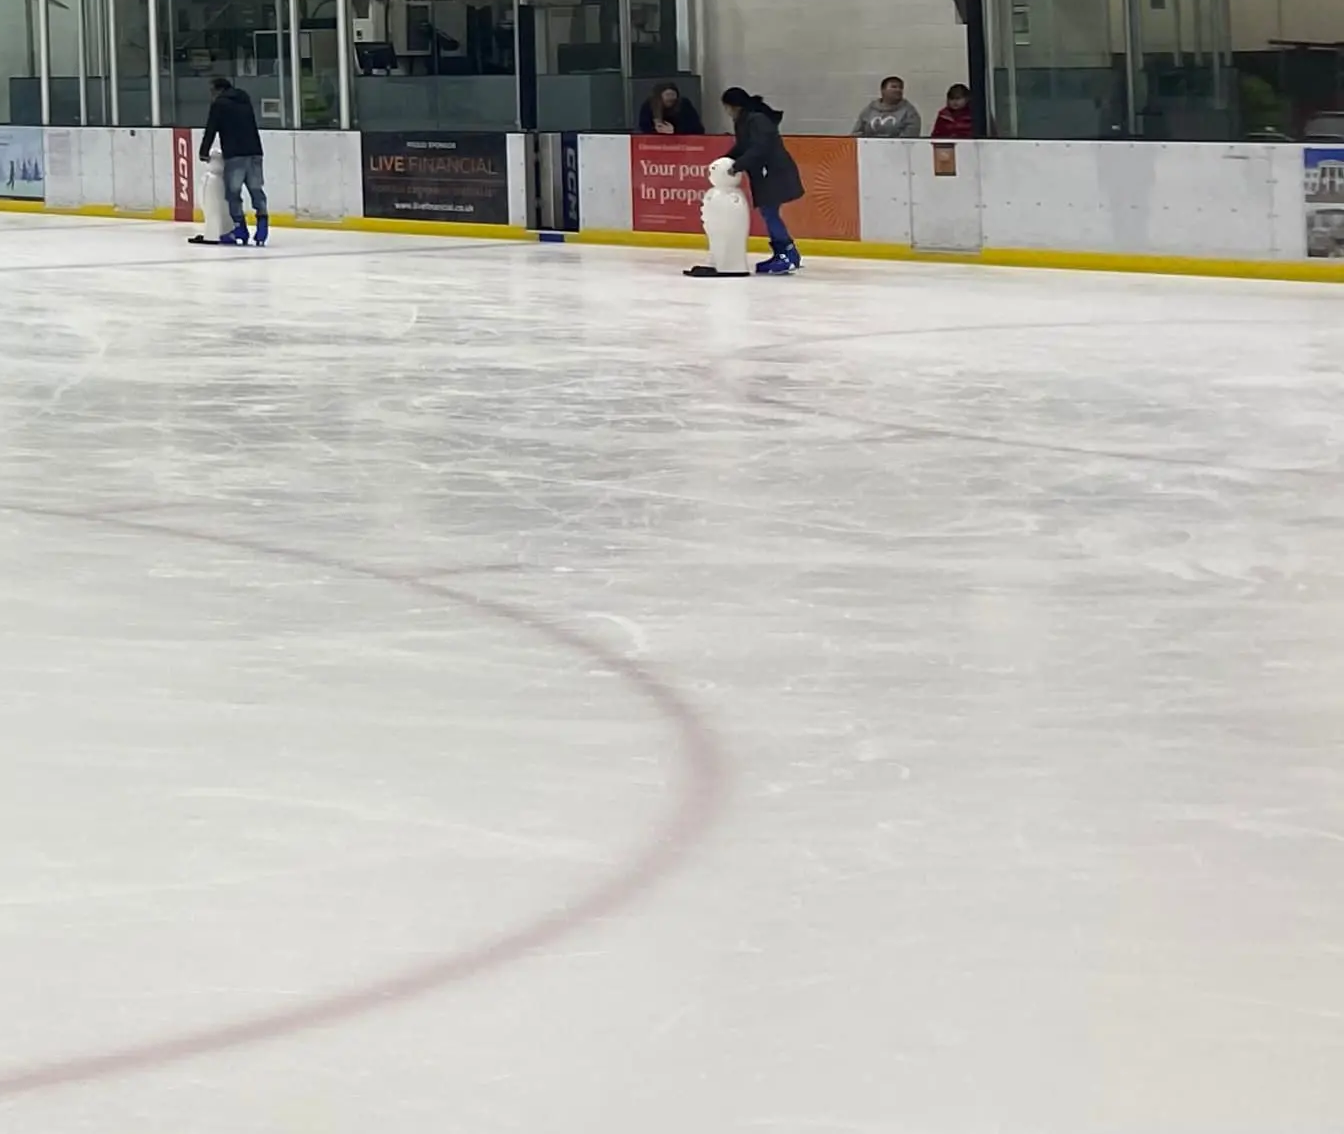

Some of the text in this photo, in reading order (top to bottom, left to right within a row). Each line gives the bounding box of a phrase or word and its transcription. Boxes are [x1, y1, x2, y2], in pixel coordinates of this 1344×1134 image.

[178, 137, 189, 202] CCM
[369, 155, 499, 176] LIVE FINANCIAL
[640, 159, 676, 177] Your
[566, 147, 578, 222] CCM
[640, 183, 657, 200] In
